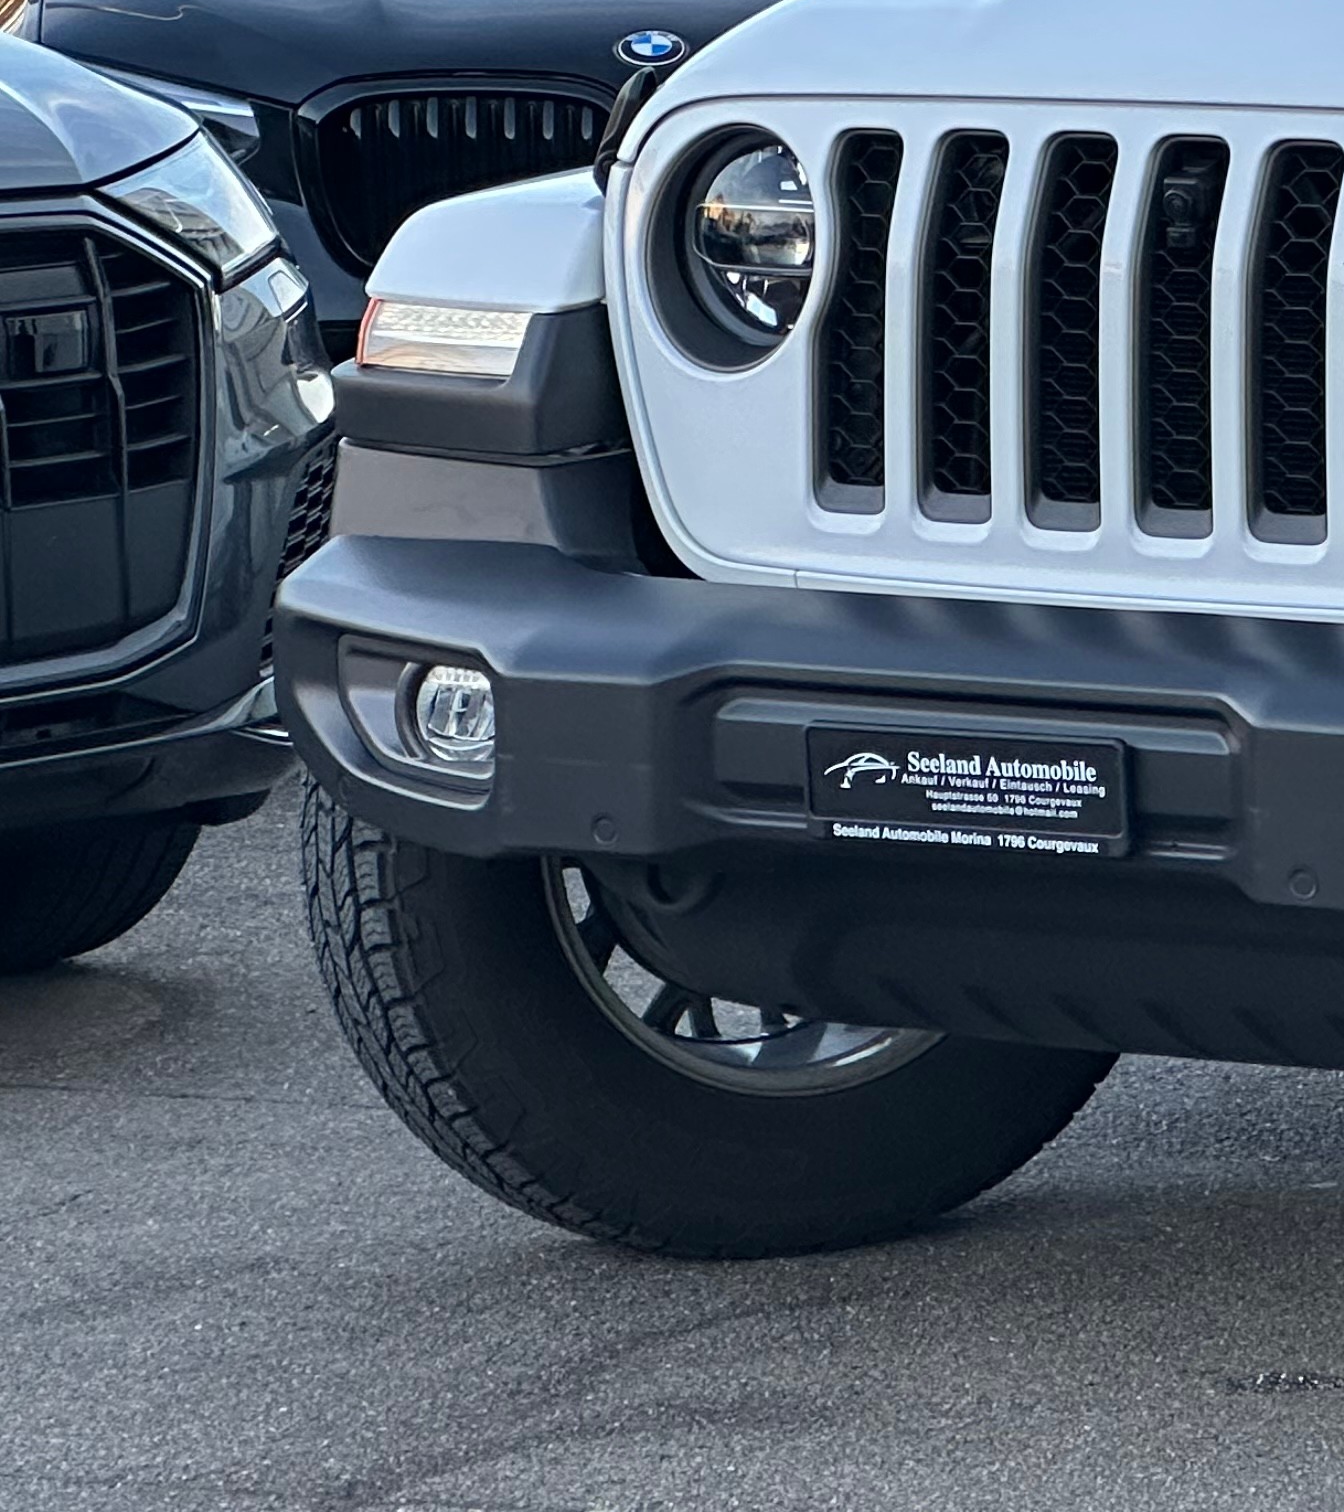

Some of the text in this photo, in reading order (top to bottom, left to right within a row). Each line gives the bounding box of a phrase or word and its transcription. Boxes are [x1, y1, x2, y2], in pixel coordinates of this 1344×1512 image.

[907, 750, 1097, 782] Seeland Automobile
[901, 773, 938, 786] Ankauf
[949, 775, 989, 789] Verkauf
[1000, 778, 1053, 792] Eintausch
[1063, 782, 1106, 798] Leasing
[926, 789, 985, 802] Hauptstrasse
[1028, 795, 1083, 808] Courgevaux
[832, 823, 1099, 854] Seeland Automobile Morina 1796 Courgevaux
